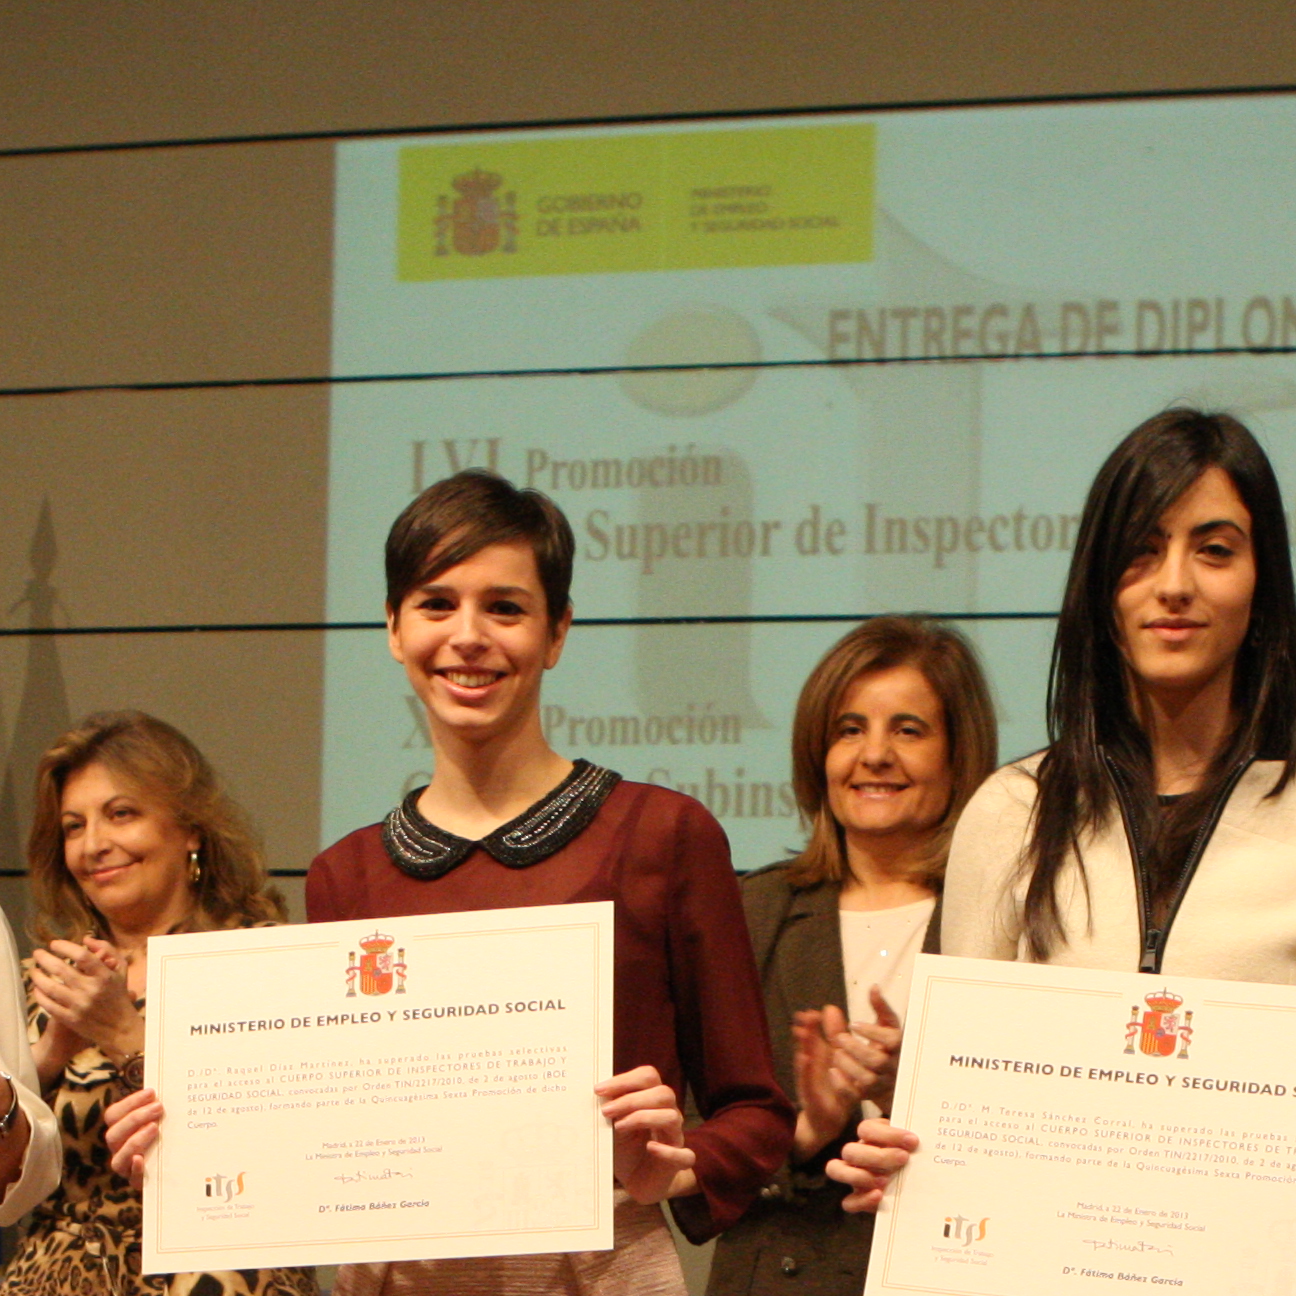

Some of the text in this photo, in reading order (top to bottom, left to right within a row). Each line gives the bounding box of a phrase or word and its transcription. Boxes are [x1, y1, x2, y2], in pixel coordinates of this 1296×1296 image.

[536, 192, 643, 214] GOBIERNO
[536, 219, 563, 237] DE
[828, 303, 1042, 363] ENTREGA
[526, 443, 723, 491] Promoción
[585, 506, 781, 575] Superior
[794, 504, 846, 556] de
[865, 502, 1080, 569] Inspector
[544, 702, 743, 748] Promoción
[189, 999, 565, 1035] MINISTERIO DE EMPLEO Y SEGURIDAD SOCIAL
[949, 1055, 1054, 1075] MINISTERIO
[1059, 1065, 1081, 1078] DE
[1087, 1068, 1158, 1085] EMPLEO
[1165, 1075, 1175, 1087] Y
[1181, 1076, 1286, 1096] SEGURIDAD
